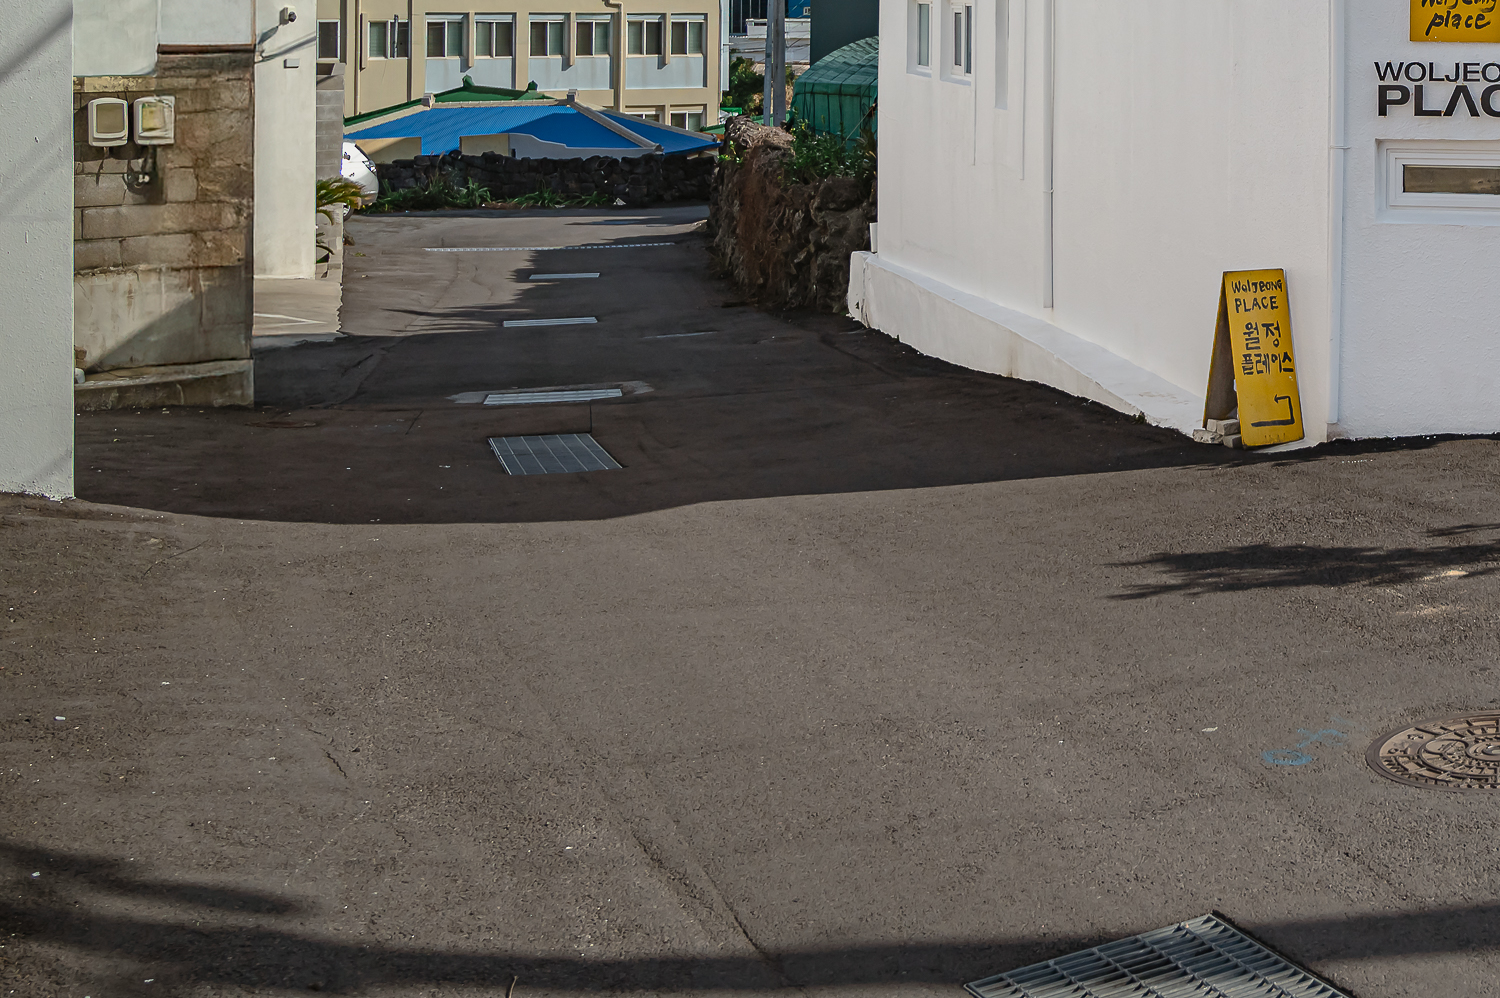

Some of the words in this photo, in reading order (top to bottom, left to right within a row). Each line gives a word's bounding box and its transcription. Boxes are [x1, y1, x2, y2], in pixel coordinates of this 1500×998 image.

[1425, 10, 1491, 36] place
[1234, 295, 1279, 313] PLACE
[1243, 320, 1282, 351] 월정
[1241, 351, 1294, 376] 플레이스
